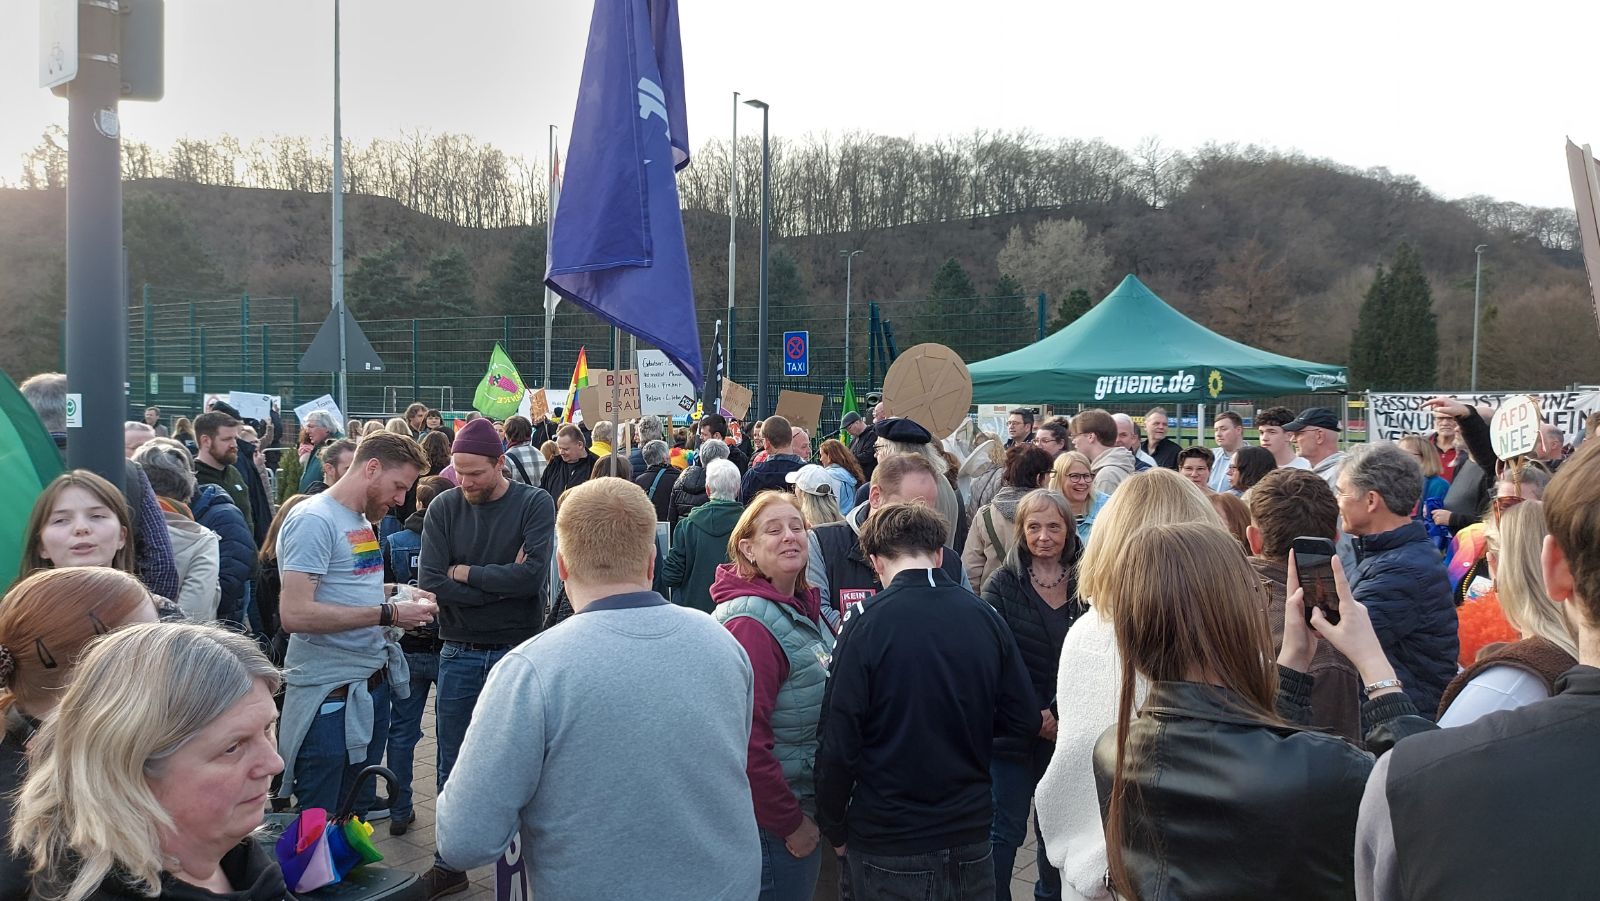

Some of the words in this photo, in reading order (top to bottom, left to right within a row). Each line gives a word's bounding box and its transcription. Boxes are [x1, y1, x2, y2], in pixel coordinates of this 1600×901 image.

[786, 362, 805, 372] TAXI
[1094, 370, 1195, 400] gruene.de
[605, 399, 640, 413] BRAU
[1499, 403, 1528, 431] AFD
[1499, 424, 1531, 456] NEE
[843, 592, 865, 600] KEIN
